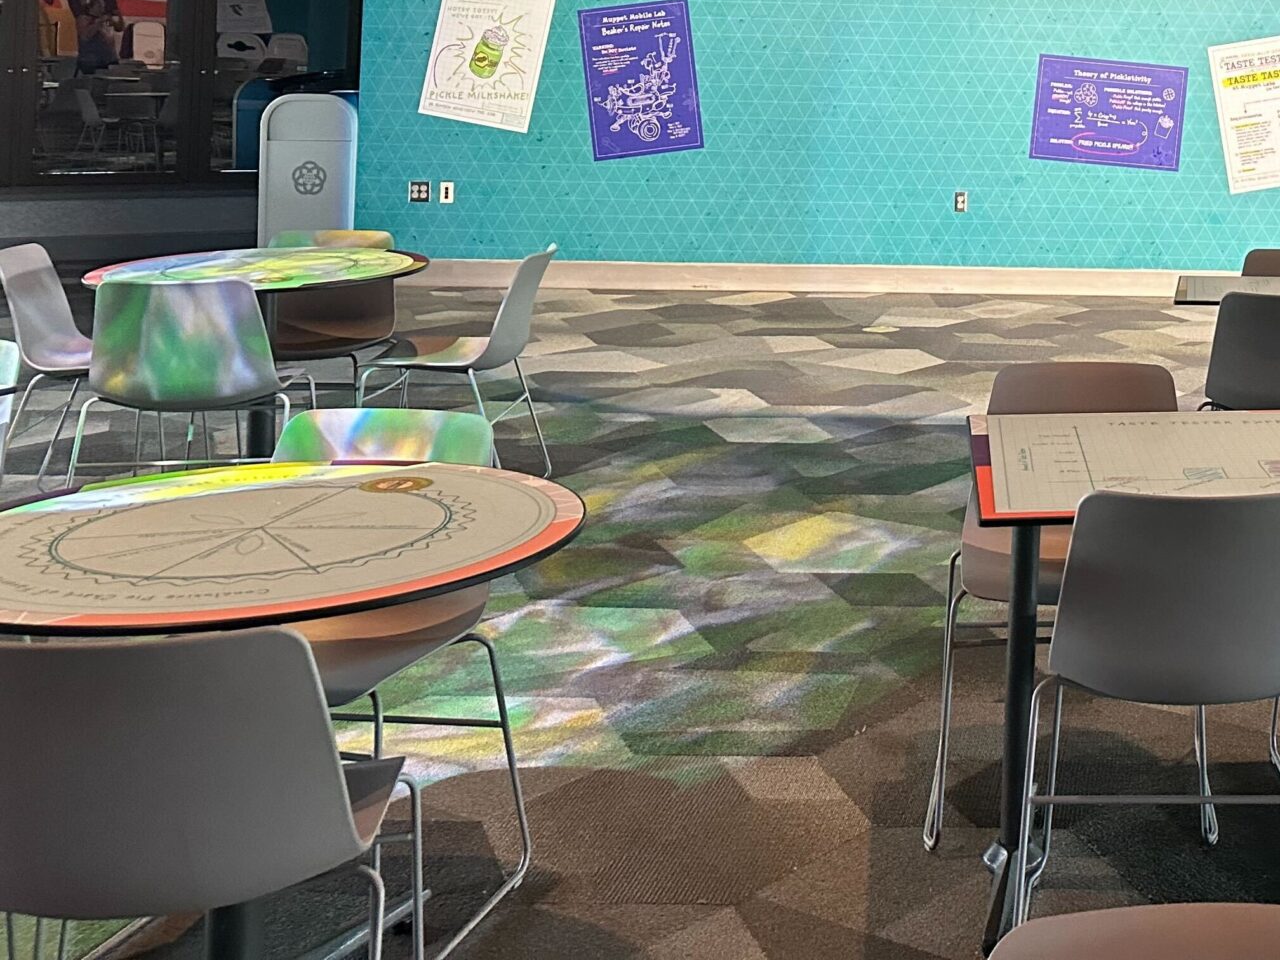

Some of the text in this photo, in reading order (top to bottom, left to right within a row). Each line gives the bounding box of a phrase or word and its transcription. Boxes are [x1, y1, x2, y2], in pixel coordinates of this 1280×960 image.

[602, 14, 628, 23] Muppet
[629, 12, 652, 21] Mobile
[601, 20, 671, 36] Beaker's Repair Notes
[1224, 58, 1255, 71] TASTE
[1073, 70, 1098, 80] Theory
[1100, 71, 1109, 79] of
[1226, 73, 1258, 86] TASTE
[429, 90, 529, 101] PICKLE MILKSHAKE!
